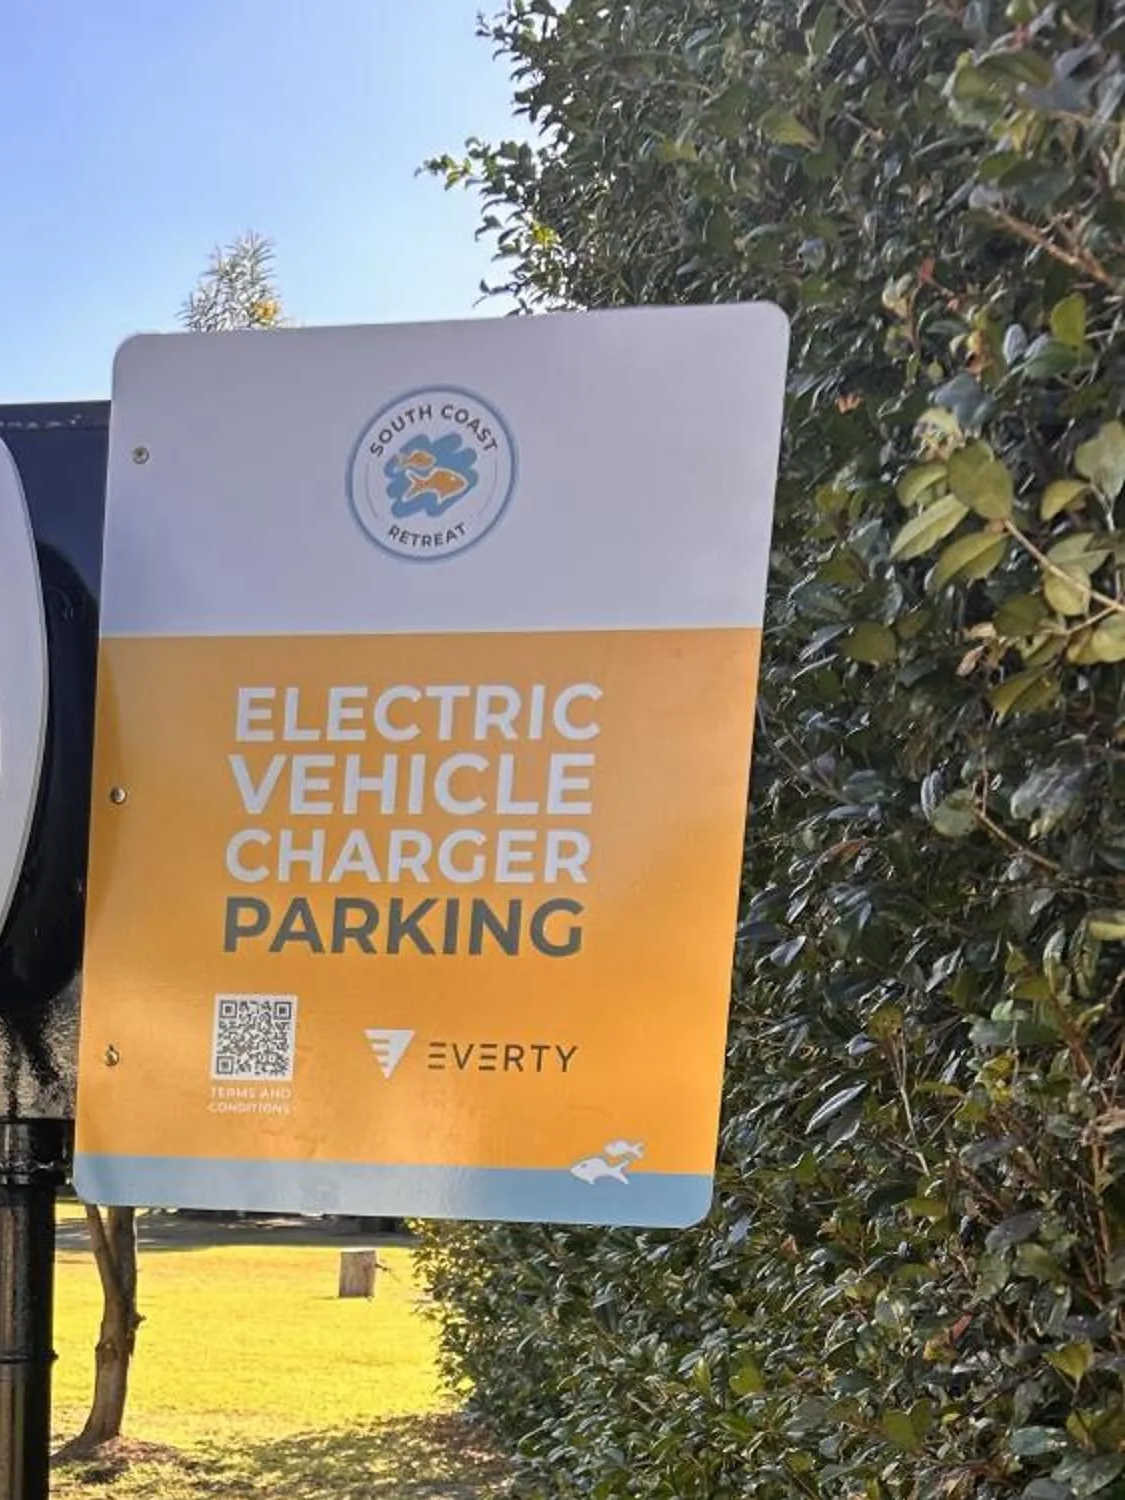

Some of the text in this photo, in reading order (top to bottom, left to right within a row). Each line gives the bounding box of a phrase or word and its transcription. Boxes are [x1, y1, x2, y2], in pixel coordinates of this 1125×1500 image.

[370, 404, 498, 458] SOUTH COAST
[388, 522, 467, 547] RETREAT
[235, 683, 604, 742] ELECTRIC
[228, 753, 596, 816] VEHICLE
[225, 828, 592, 884] CHARGER
[222, 895, 586, 957] PARKING
[427, 1041, 579, 1073] EVERTY
[207, 1102, 291, 1115] CONDITIONS
[210, 1086, 293, 1100] TERMS AND
